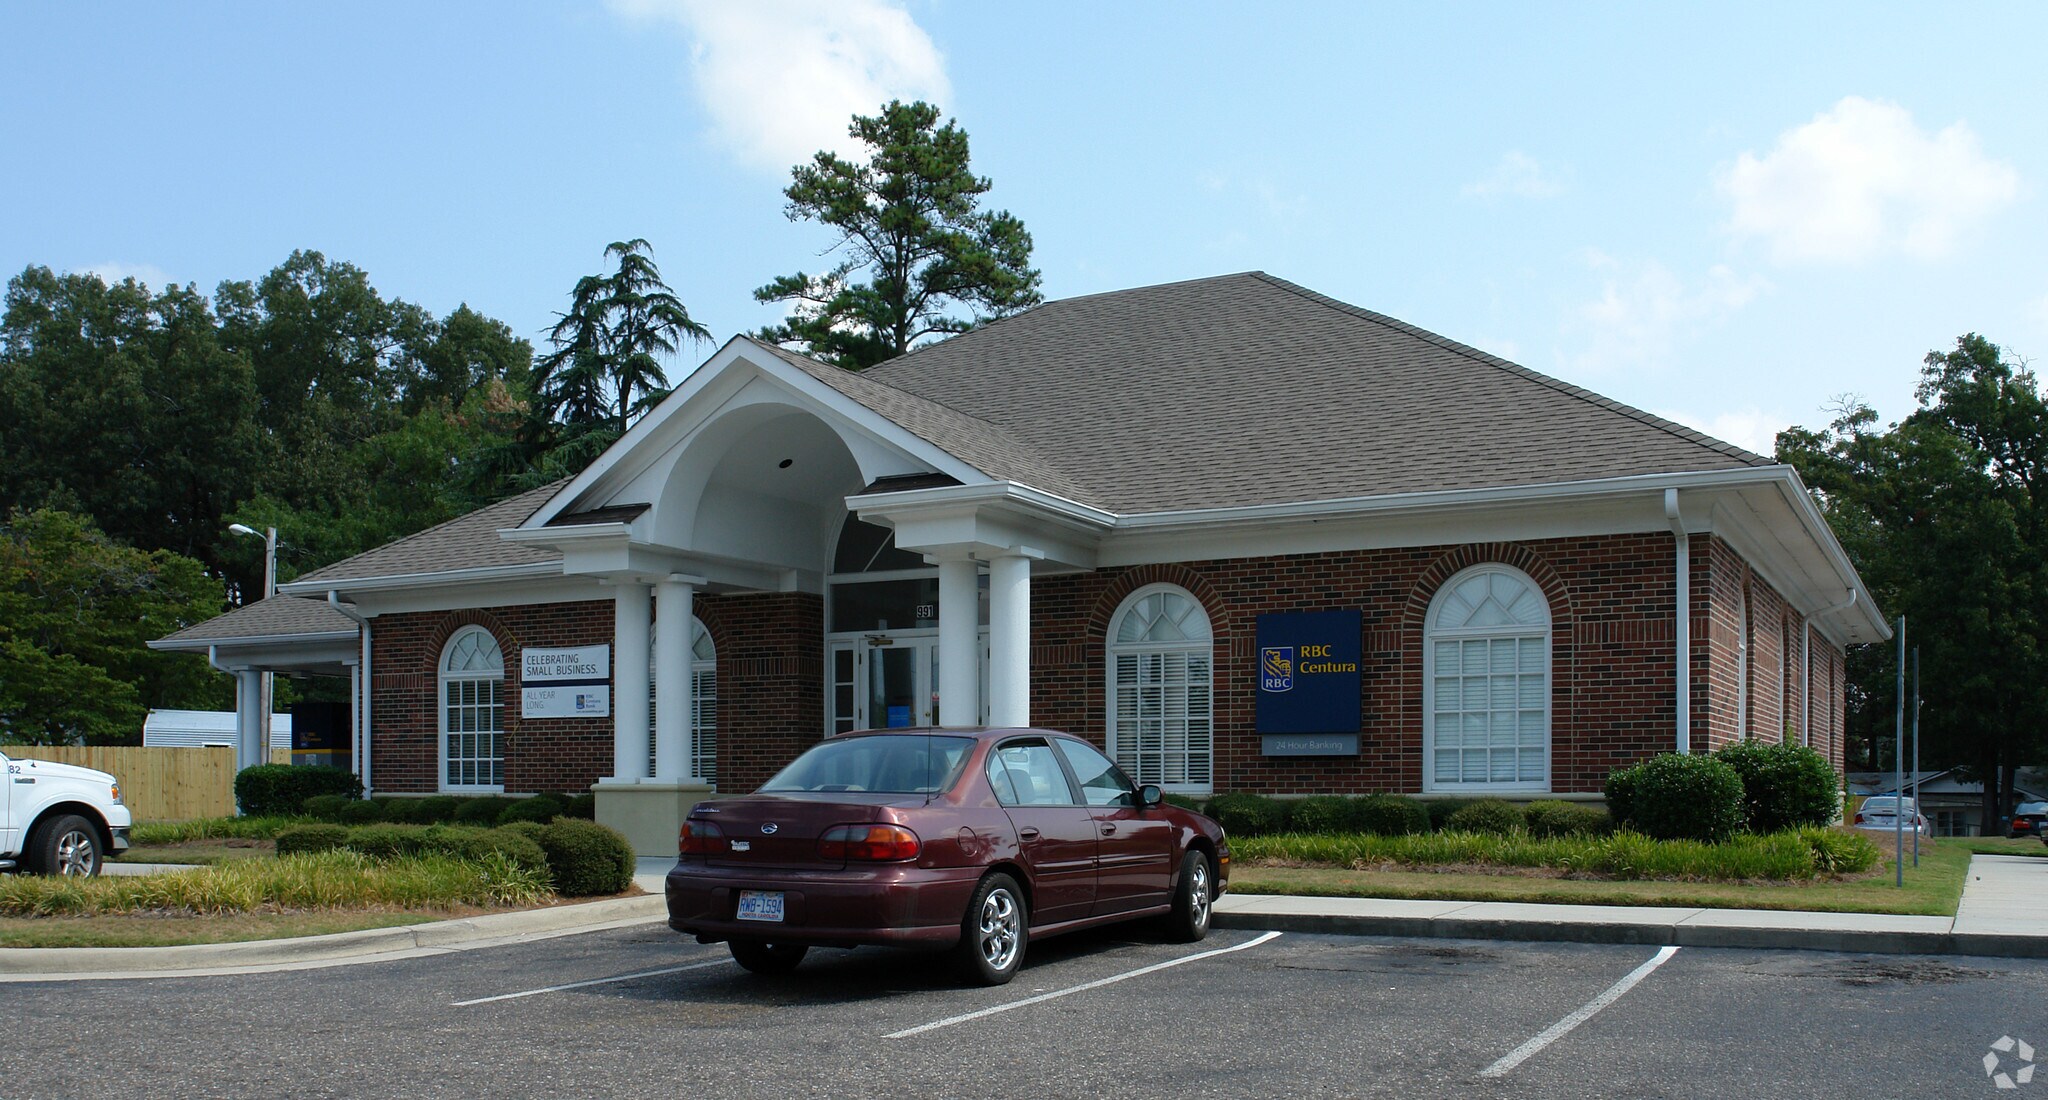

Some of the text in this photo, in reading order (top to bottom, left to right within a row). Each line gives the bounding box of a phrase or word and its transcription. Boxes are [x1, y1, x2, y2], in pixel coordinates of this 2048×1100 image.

[917, 606, 933, 617] 991
[1300, 645, 1332, 658] RBC
[526, 653, 579, 666] CELEBRATING
[526, 663, 599, 677] SMALL BUSINESS.
[1300, 662, 1357, 674] Centura
[1265, 678, 1290, 689] RBC
[526, 690, 556, 700] ALL YEAR
[1276, 740, 1343, 751] 24 Hour Banking
[8, 765, 21, 775] 82
